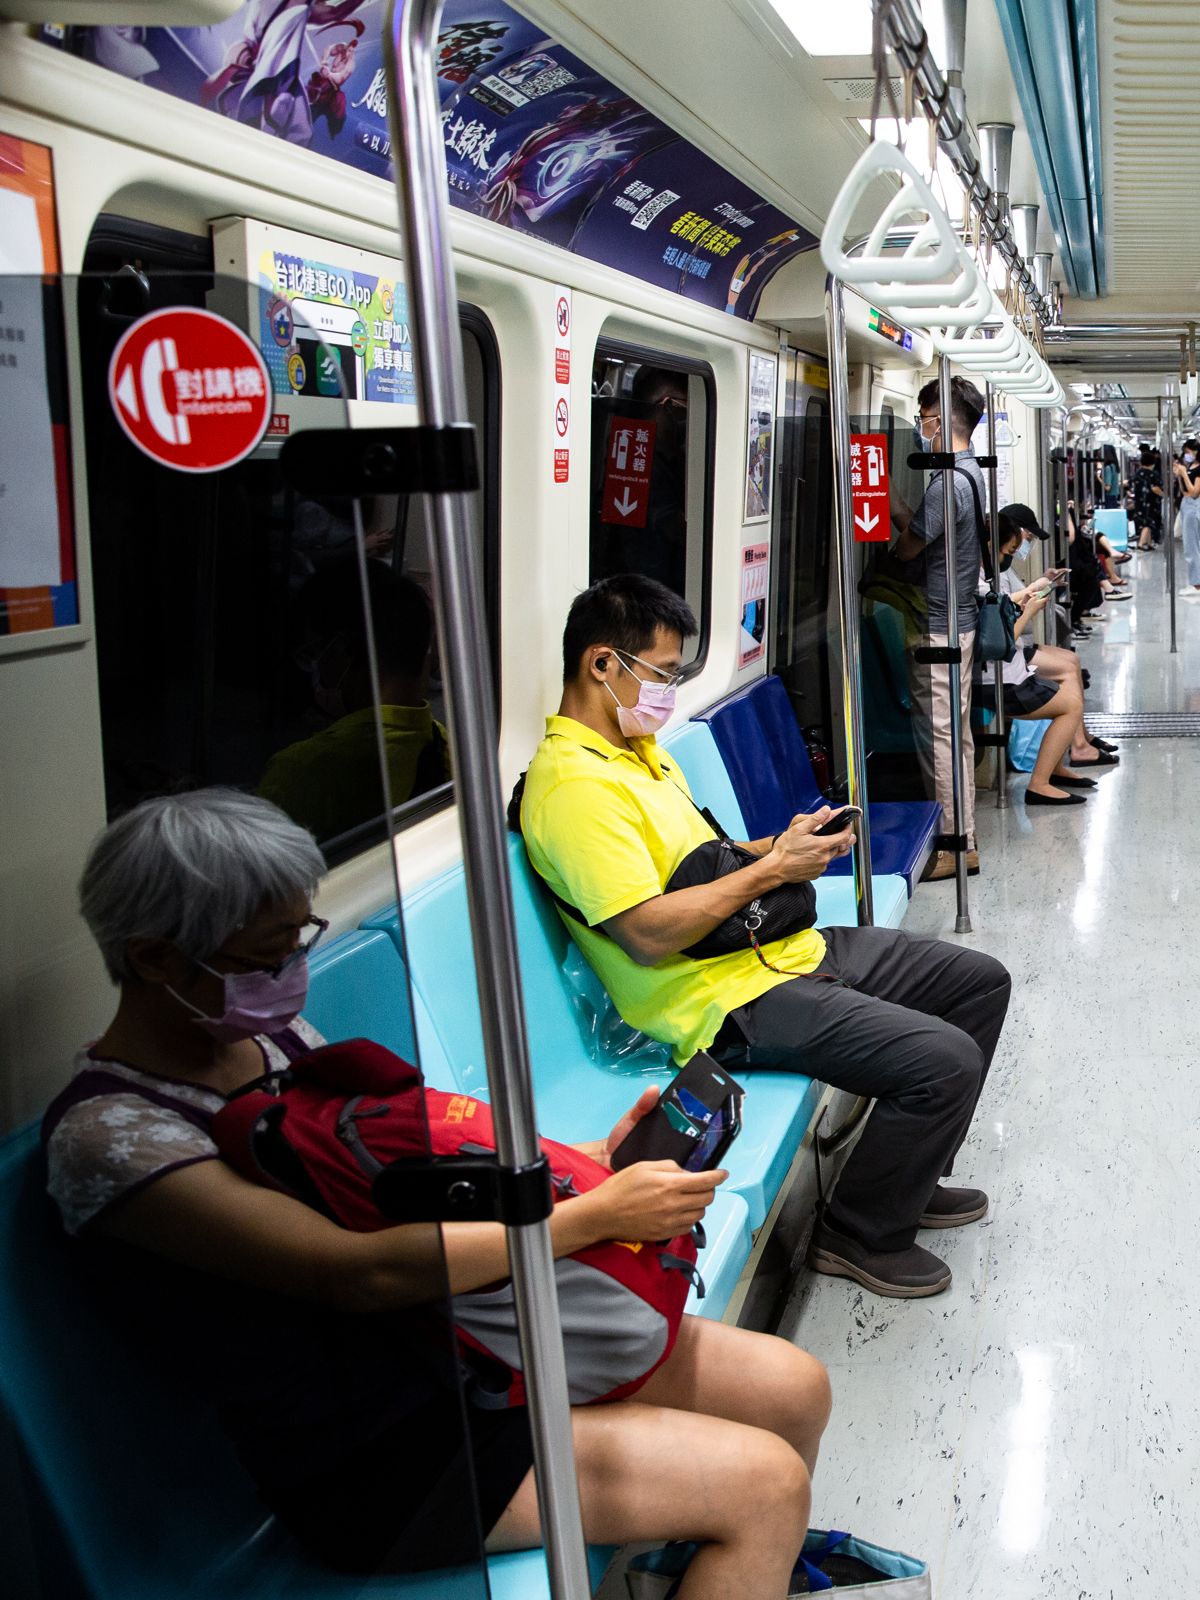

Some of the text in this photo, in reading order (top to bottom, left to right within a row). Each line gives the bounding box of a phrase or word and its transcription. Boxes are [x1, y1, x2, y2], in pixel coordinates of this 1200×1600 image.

[275, 260, 371, 308] 台北捷運GO App
[174, 367, 264, 399] 對講機
[176, 400, 252, 416] Intercom
[855, 490, 887, 498] Extinguisher
